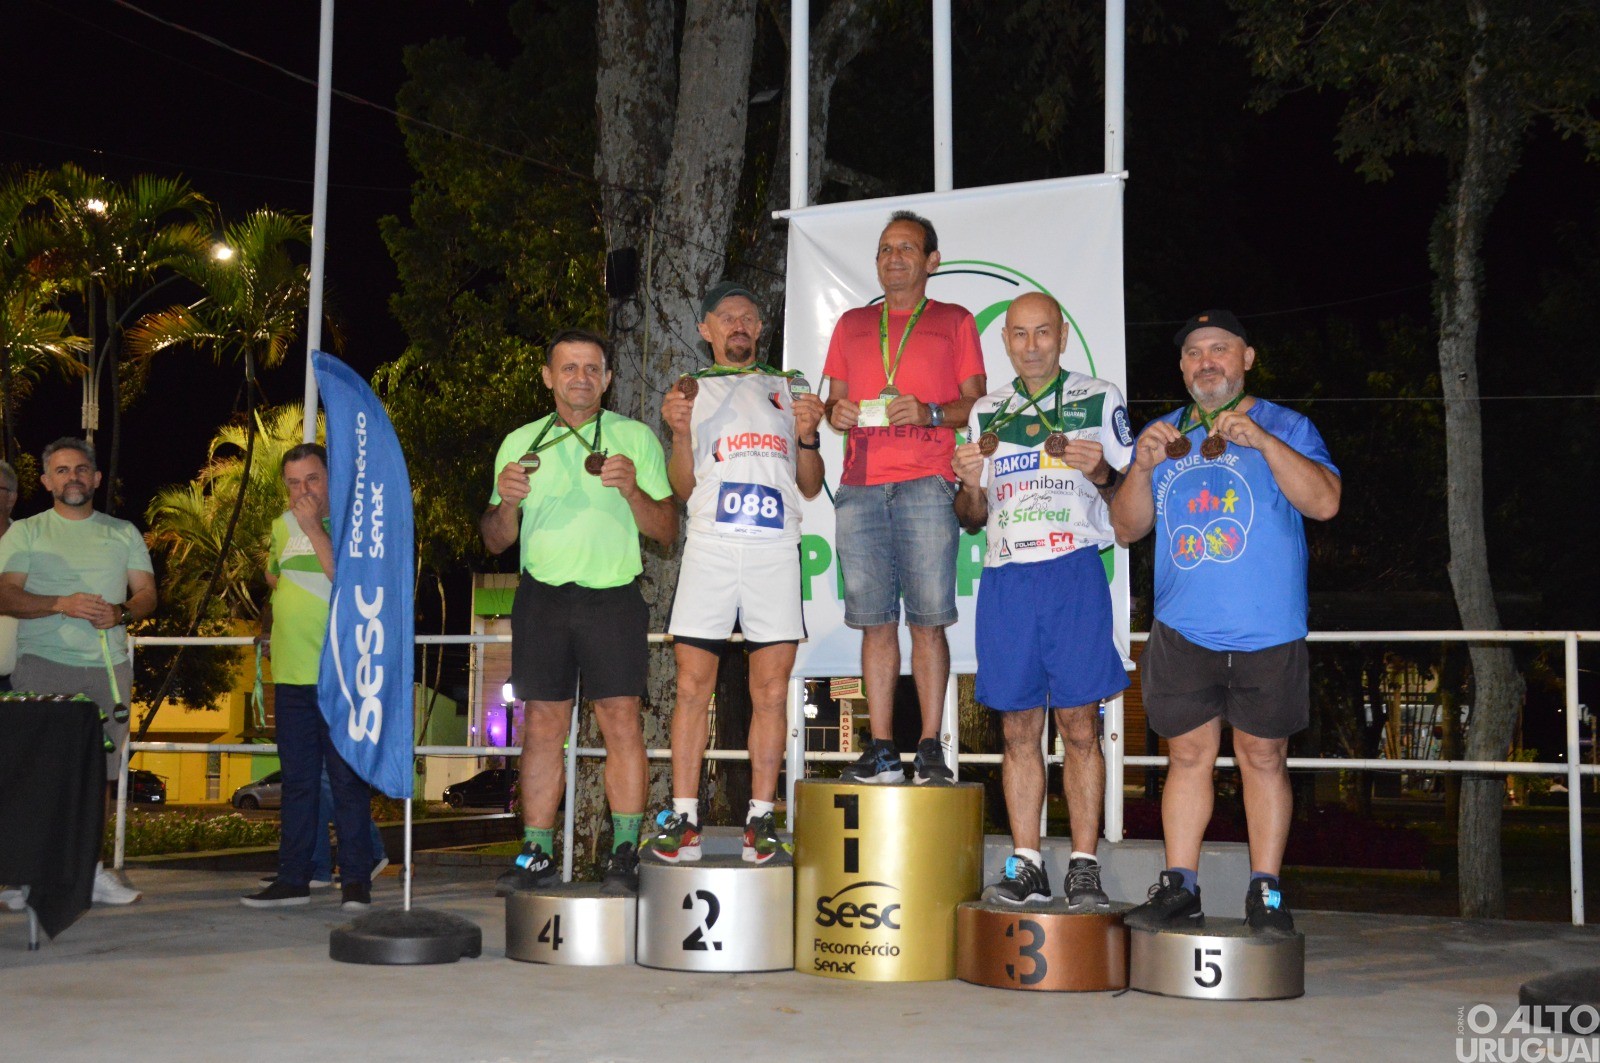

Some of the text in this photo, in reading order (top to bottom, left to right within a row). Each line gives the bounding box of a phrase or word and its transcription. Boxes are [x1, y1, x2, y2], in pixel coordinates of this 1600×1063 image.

[727, 432, 788, 455] KAPASS
[1114, 409, 1133, 445] Catedral
[995, 453, 1039, 476] BAKOF
[1174, 454, 1200, 472] QUE
[350, 412, 367, 558] Fecomércio
[1019, 475, 1074, 491] uniban
[369, 482, 384, 559] Senac
[723, 492, 778, 519] 088
[1012, 508, 1071, 524] Sicredi
[1051, 545, 1076, 553] FOLHA
[347, 584, 384, 746] Sesc
[833, 794, 859, 874] 1
[682, 889, 723, 951] 2
[815, 895, 901, 930] Sesc
[537, 914, 564, 951] 4
[813, 938, 900, 957] Fecomércio
[813, 957, 856, 974] Senac
[1005, 919, 1048, 986] 3
[1193, 947, 1222, 989] 5
